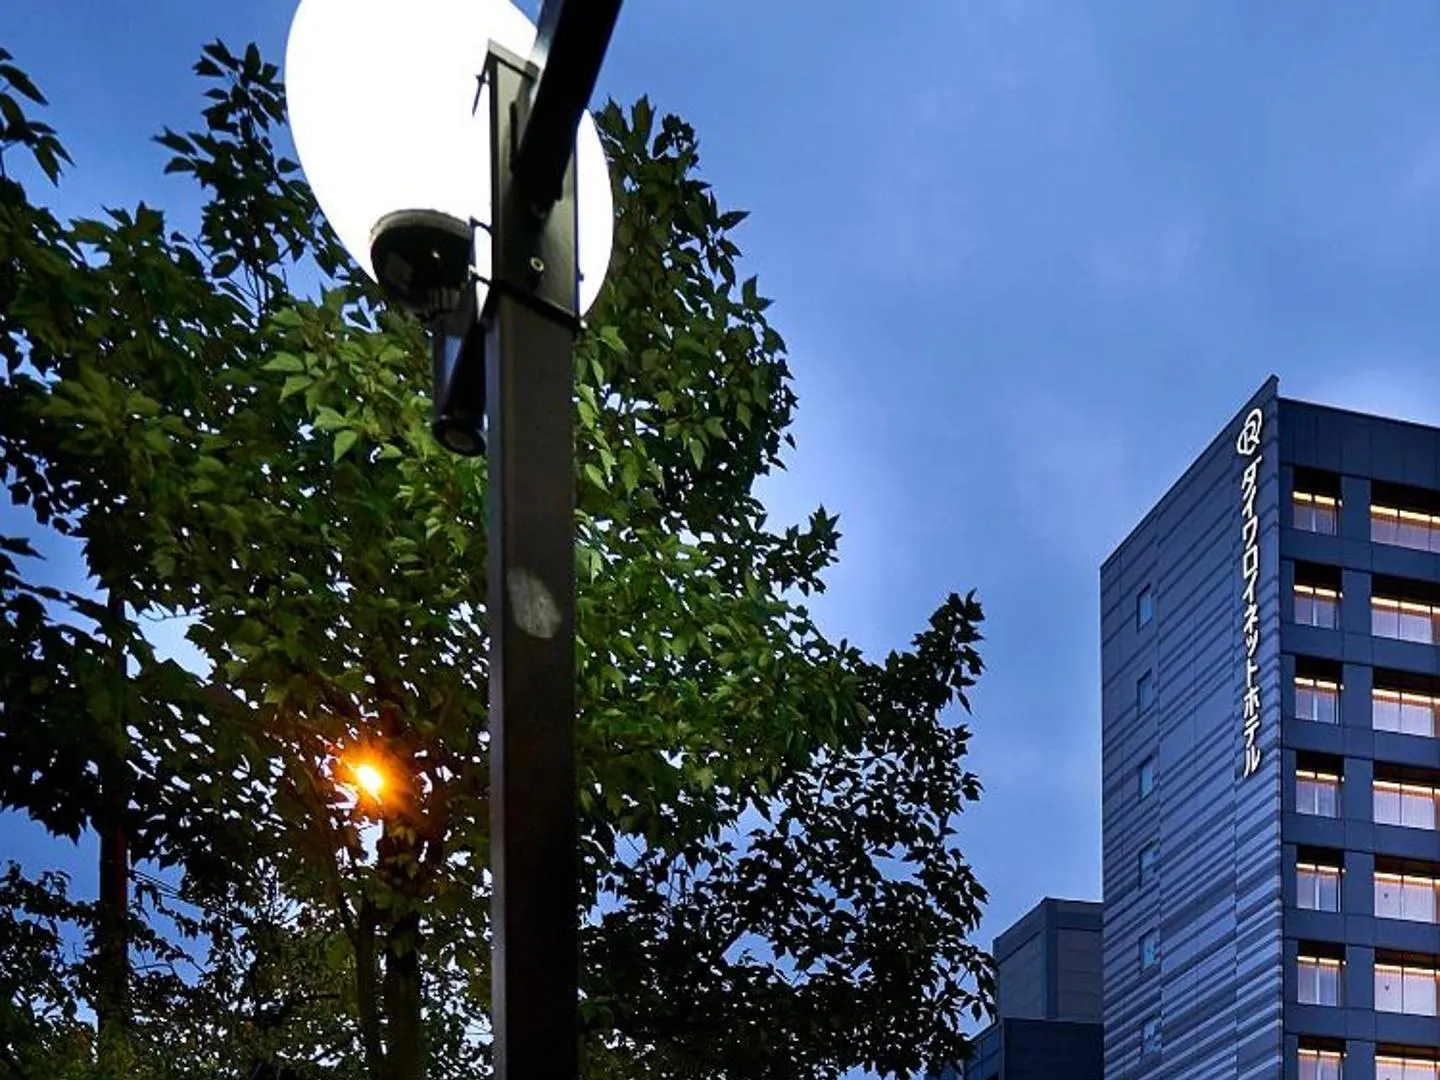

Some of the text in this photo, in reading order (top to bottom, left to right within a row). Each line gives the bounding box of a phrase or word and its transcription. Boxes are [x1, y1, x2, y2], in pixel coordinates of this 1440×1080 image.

[1241, 455, 1263, 777] ダイワロイネットホテル
